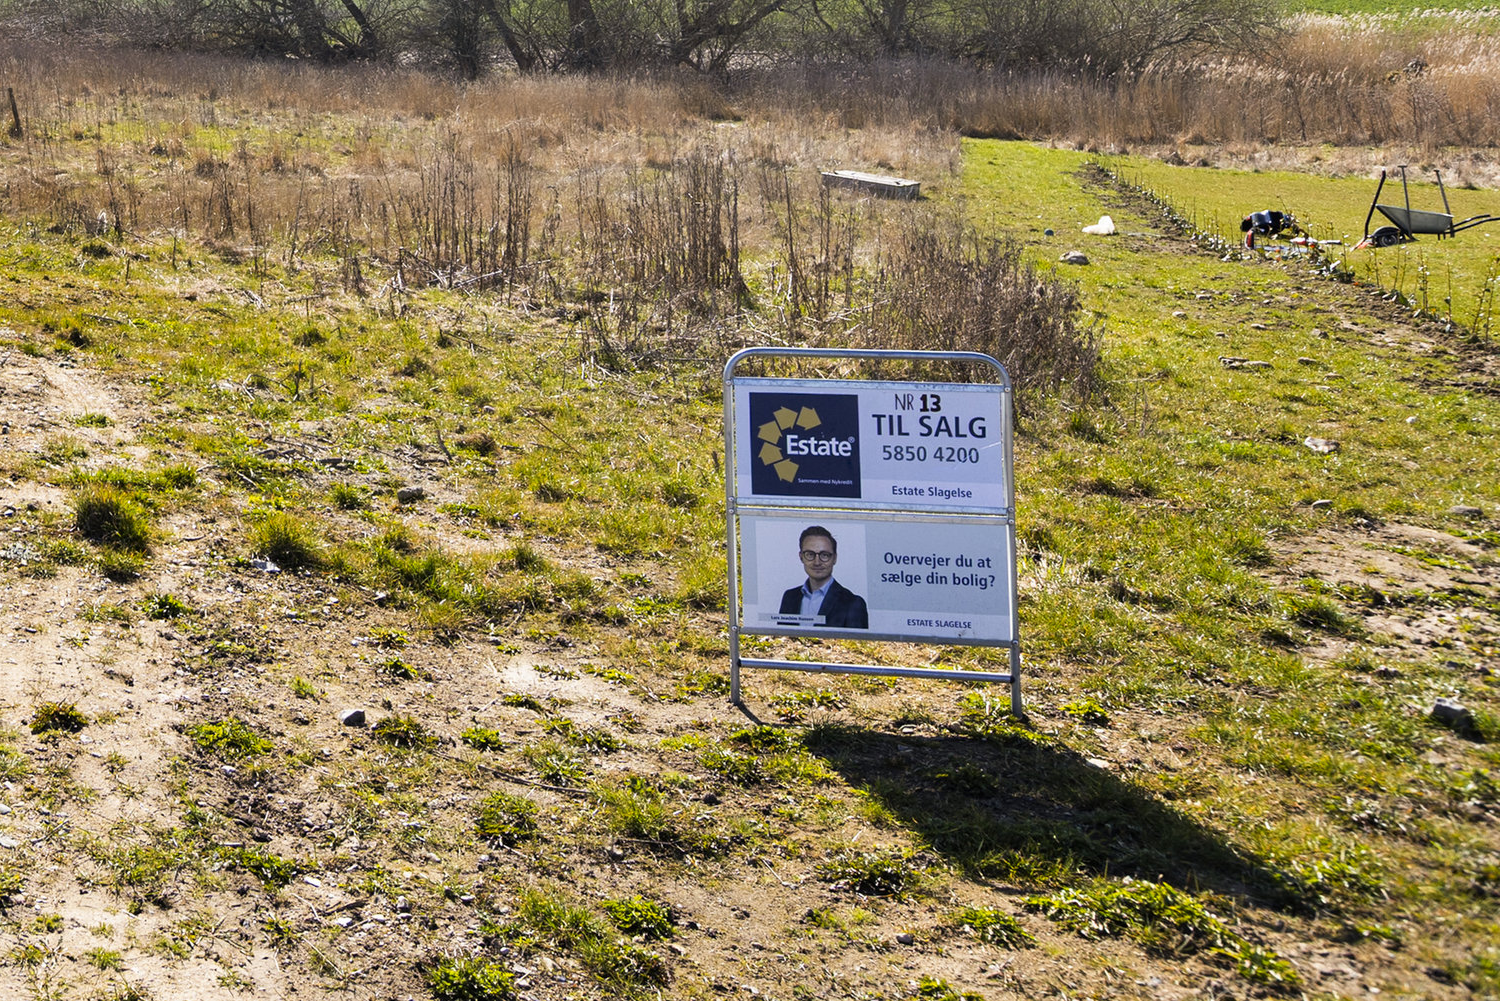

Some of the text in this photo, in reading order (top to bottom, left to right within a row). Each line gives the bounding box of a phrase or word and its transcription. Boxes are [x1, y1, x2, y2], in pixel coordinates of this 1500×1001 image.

[894, 393, 942, 412] NR 13
[871, 414, 987, 438] TIL SALG
[786, 434, 852, 457] Estate
[882, 445, 980, 464] 5850 4200
[891, 485, 973, 500] Estate Slagelse
[883, 551, 992, 570] Overvejer du at
[881, 570, 996, 590] sælge din bolig?
[906, 618, 972, 629] ESTATE SLAGELSE
